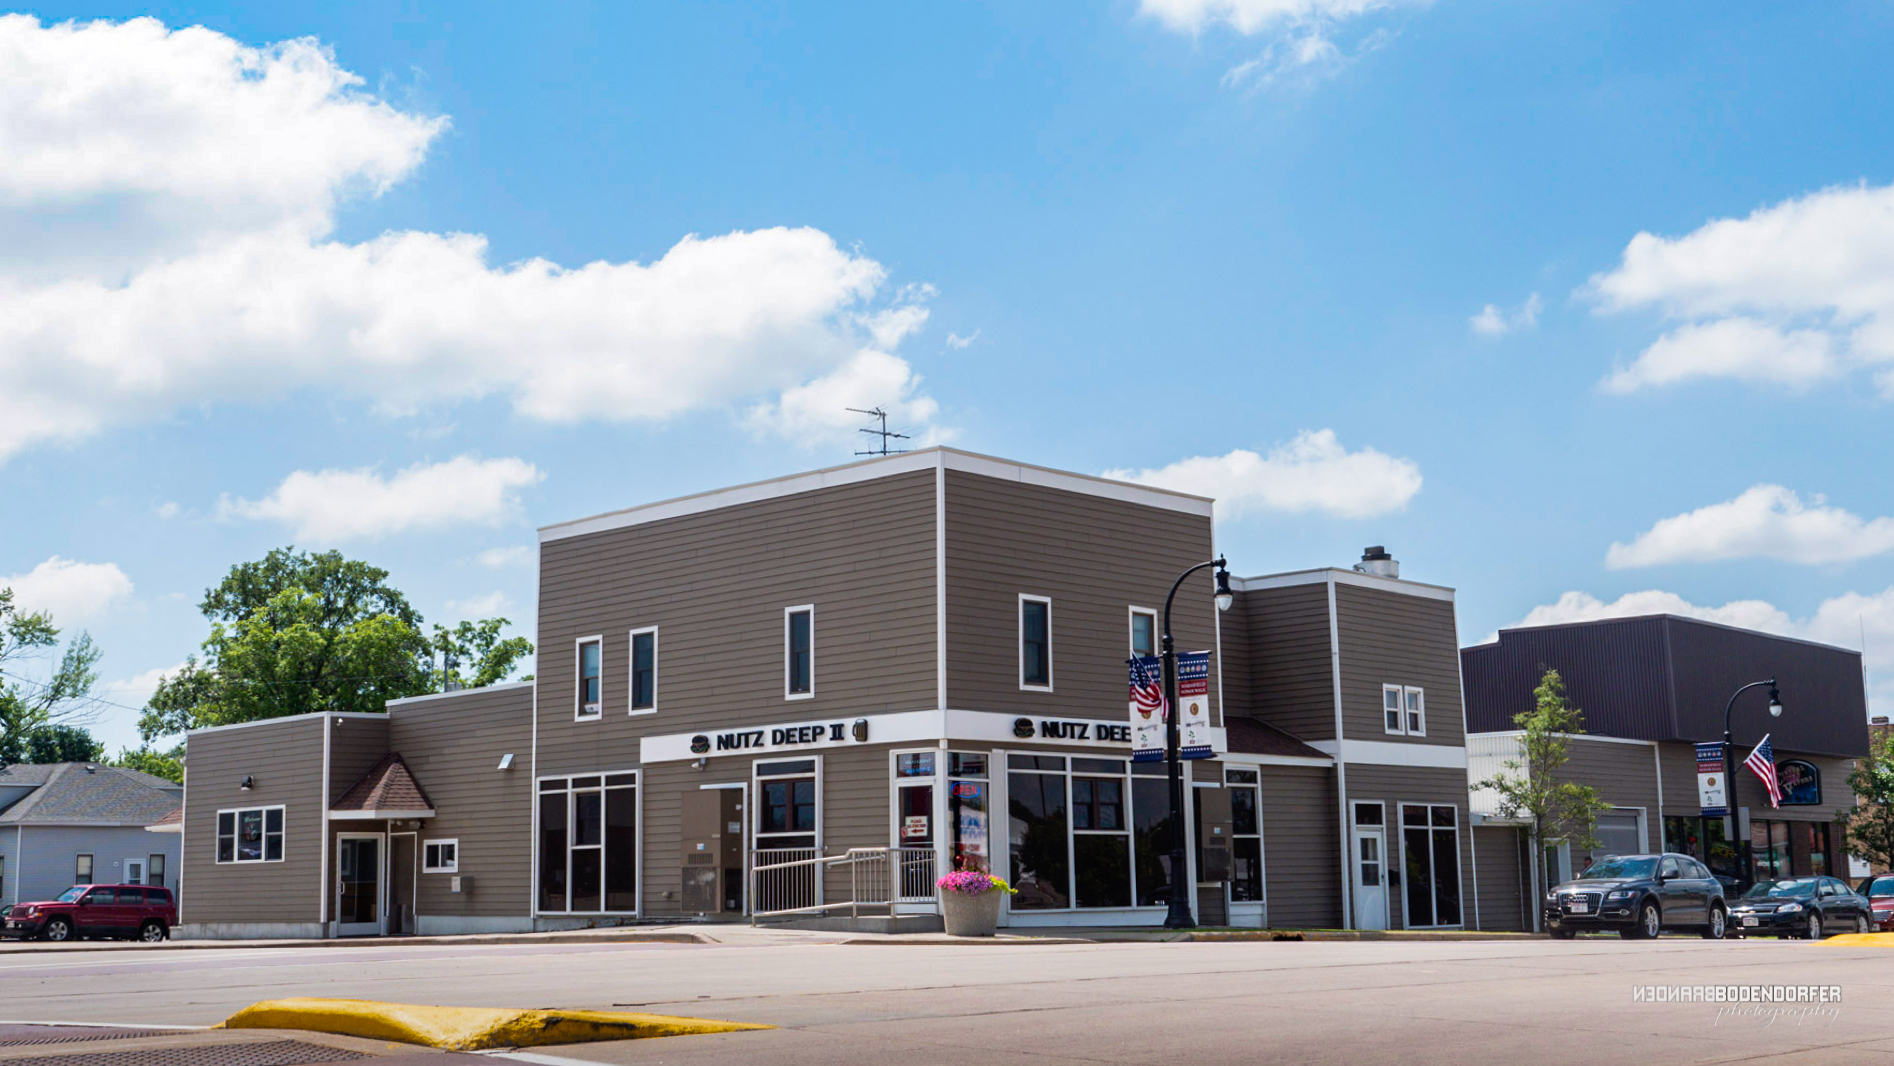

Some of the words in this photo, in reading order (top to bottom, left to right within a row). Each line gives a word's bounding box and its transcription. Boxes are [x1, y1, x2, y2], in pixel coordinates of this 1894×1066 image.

[717, 730, 764, 751] NUTZ
[772, 725, 825, 745] DEEP
[829, 723, 845, 741] II
[1041, 720, 1090, 740] NUTZ
[1097, 724, 1131, 742] DEE
[953, 785, 977, 795] OPEN
